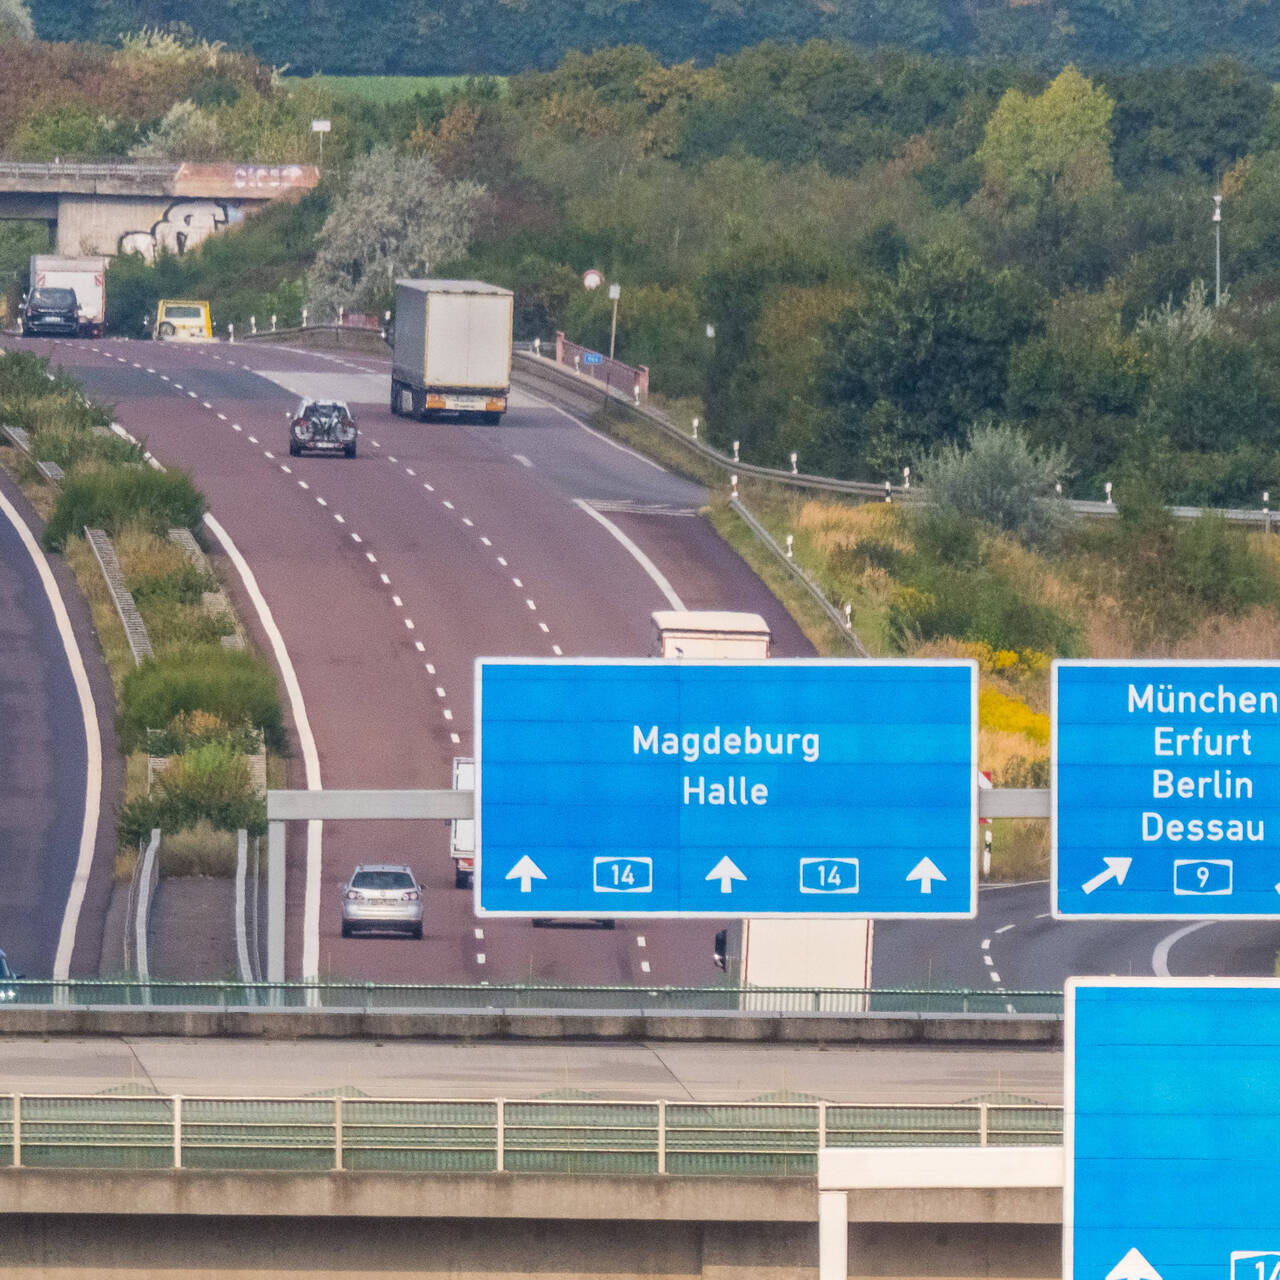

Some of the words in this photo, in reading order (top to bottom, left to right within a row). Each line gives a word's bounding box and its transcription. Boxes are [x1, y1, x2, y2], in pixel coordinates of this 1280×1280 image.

[1128, 684, 1278, 714] München
[633, 725, 820, 763] Magdeburg
[1154, 726, 1252, 756] Erfurt
[683, 775, 769, 806] Halle
[1153, 769, 1253, 799] Berlin
[1142, 811, 1265, 842] Dessau
[611, 863, 635, 886] 14
[818, 865, 841, 886] 14
[1196, 866, 1210, 888] 9
